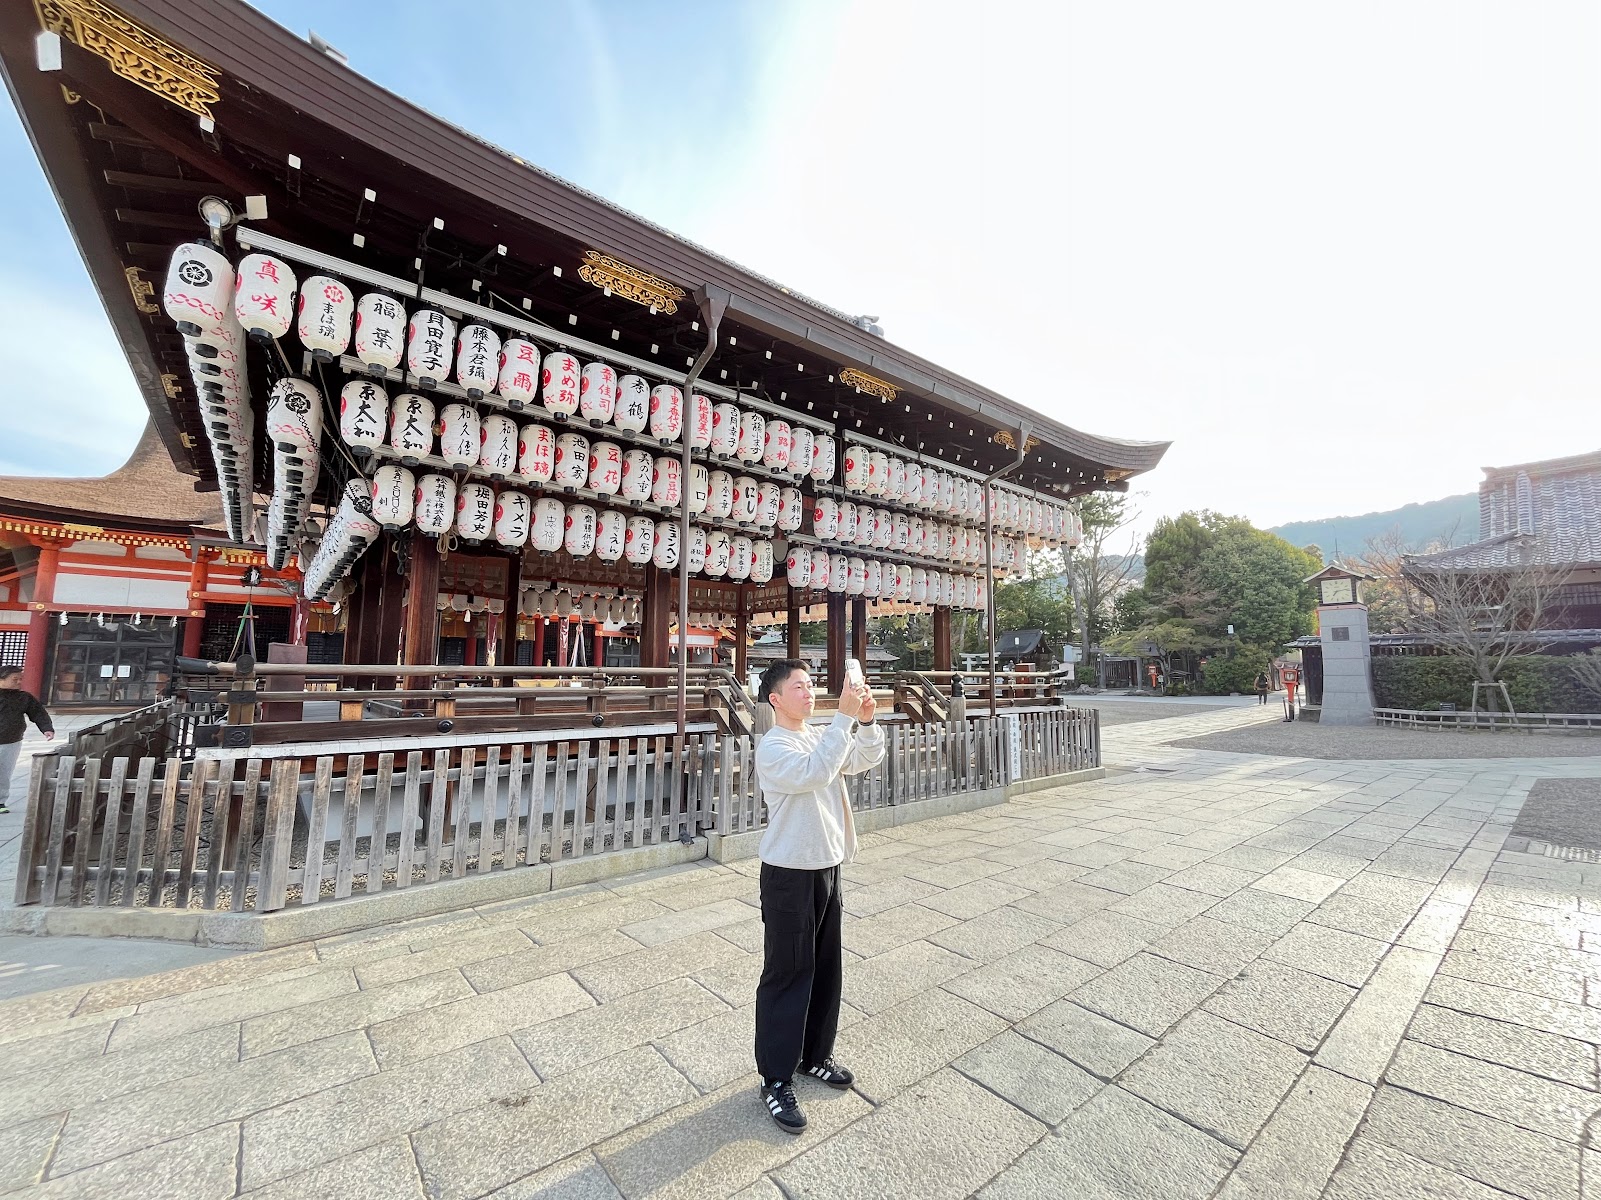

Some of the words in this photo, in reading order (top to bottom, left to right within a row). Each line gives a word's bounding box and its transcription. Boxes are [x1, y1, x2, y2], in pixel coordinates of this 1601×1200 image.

[252, 260, 279, 316] 真咲
[559, 357, 576, 405] まめ弥
[533, 428, 550, 476] まほ璃
[572, 436, 586, 480] 池田家
[604, 447, 619, 485] 豆花
[695, 468, 707, 501] 川口
[510, 495, 526, 538] キメラ
